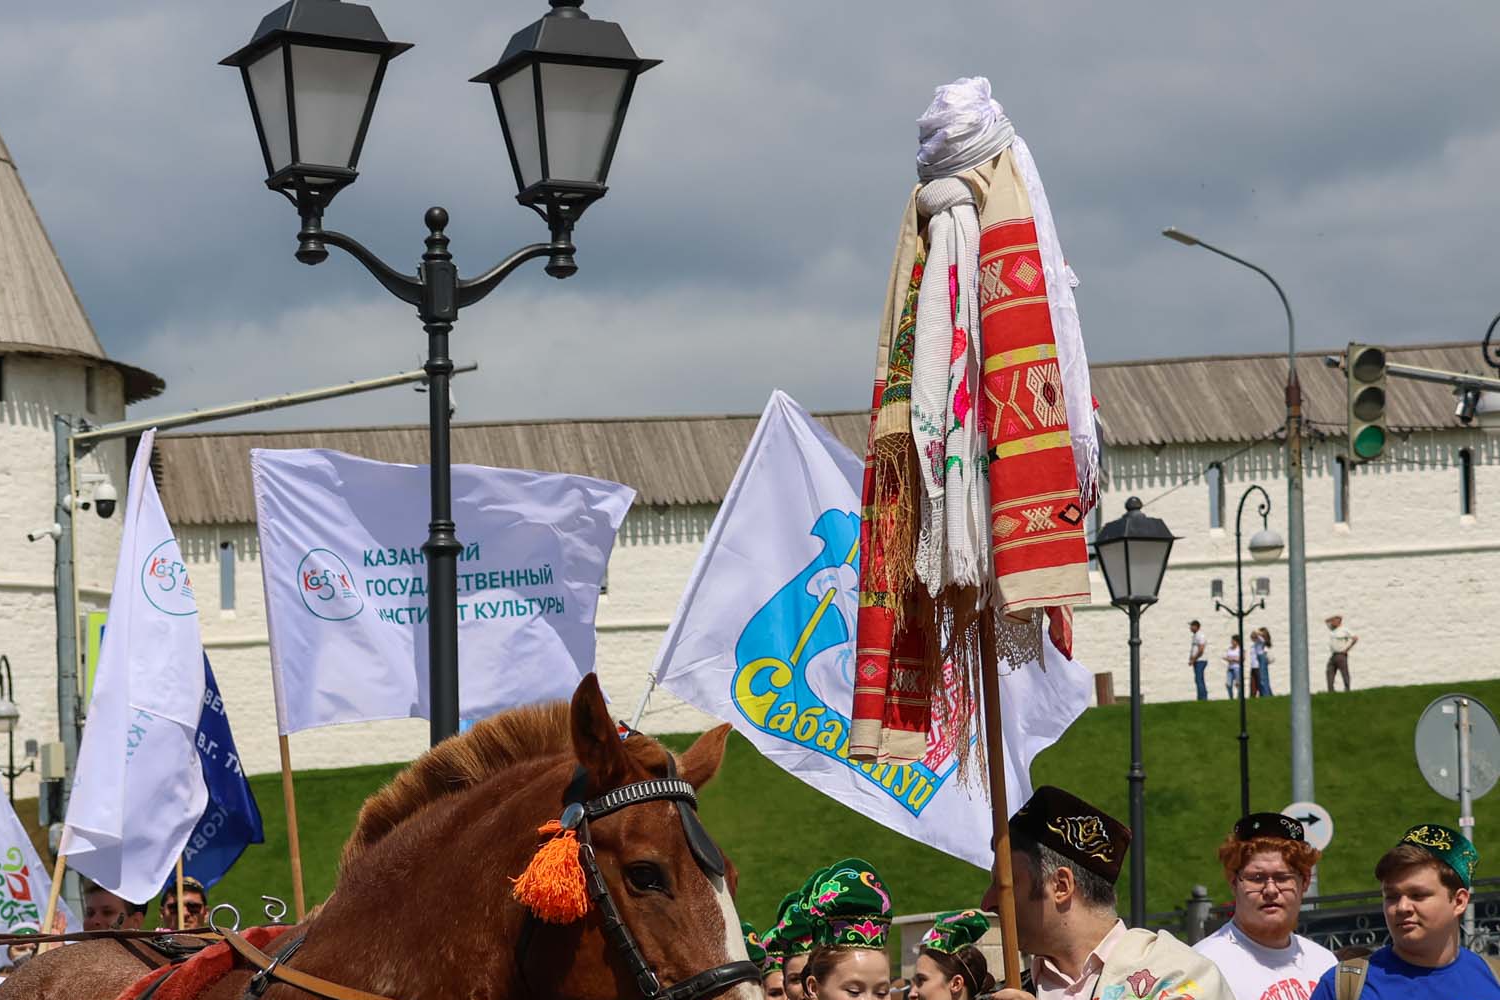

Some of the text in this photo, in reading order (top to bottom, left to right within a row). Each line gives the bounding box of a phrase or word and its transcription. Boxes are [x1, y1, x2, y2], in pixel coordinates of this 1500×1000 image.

[363, 542, 480, 568] КАЗАНЙ
[365, 563, 554, 598] ГОСУДТВЕННЫЙ
[374, 596, 565, 625] ИНСТИТ КУЛЬТУРЫ
